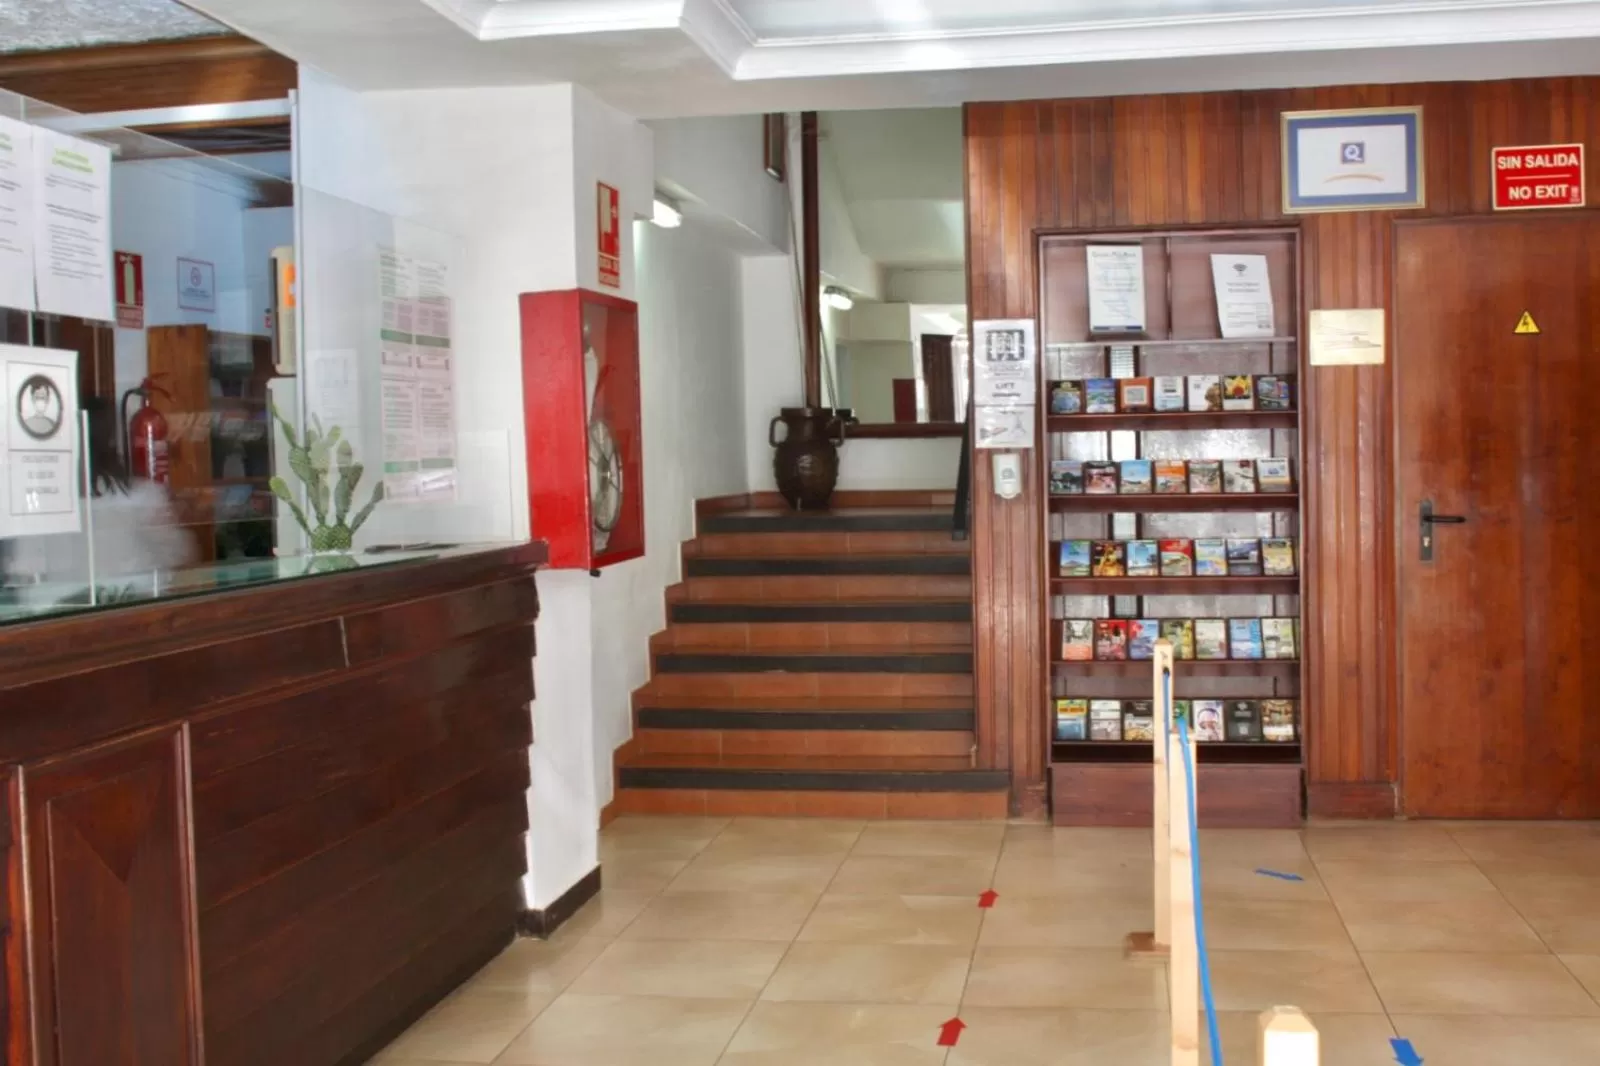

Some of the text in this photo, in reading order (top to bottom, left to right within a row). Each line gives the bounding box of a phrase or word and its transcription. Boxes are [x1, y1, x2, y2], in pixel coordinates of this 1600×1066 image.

[1497, 153, 1579, 170] SIN SALIDA
[1508, 186, 1532, 200] NO
[1535, 184, 1568, 198] EXIT
